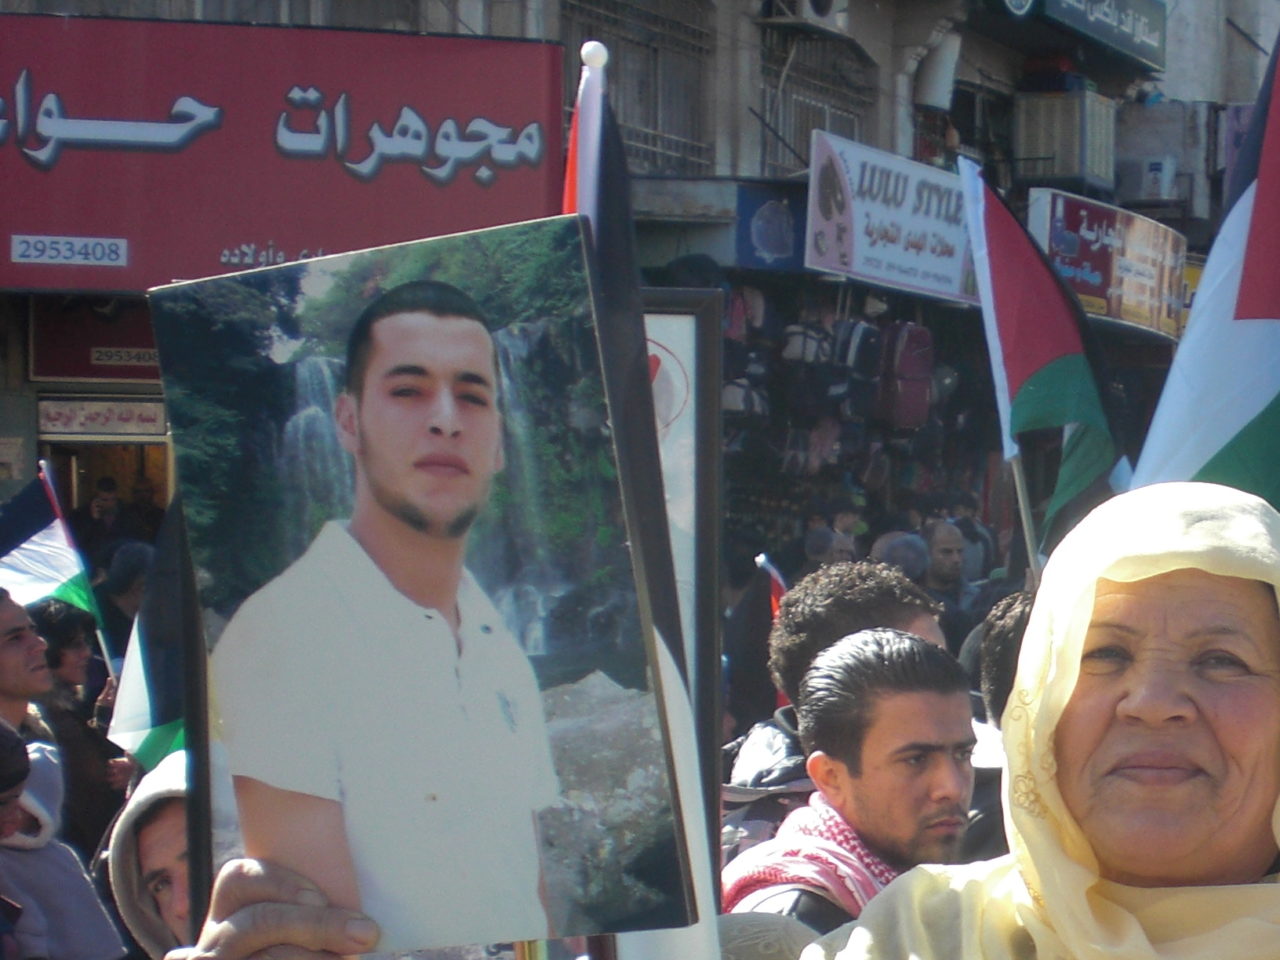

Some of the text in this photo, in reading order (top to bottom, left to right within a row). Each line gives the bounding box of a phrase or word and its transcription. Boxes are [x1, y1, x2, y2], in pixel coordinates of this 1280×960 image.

[0, 68, 545, 182] مجوهرات حوا
[856, 160, 909, 209] LULU
[912, 178, 965, 226] STYLE
[18, 238, 121, 262] 2953408
